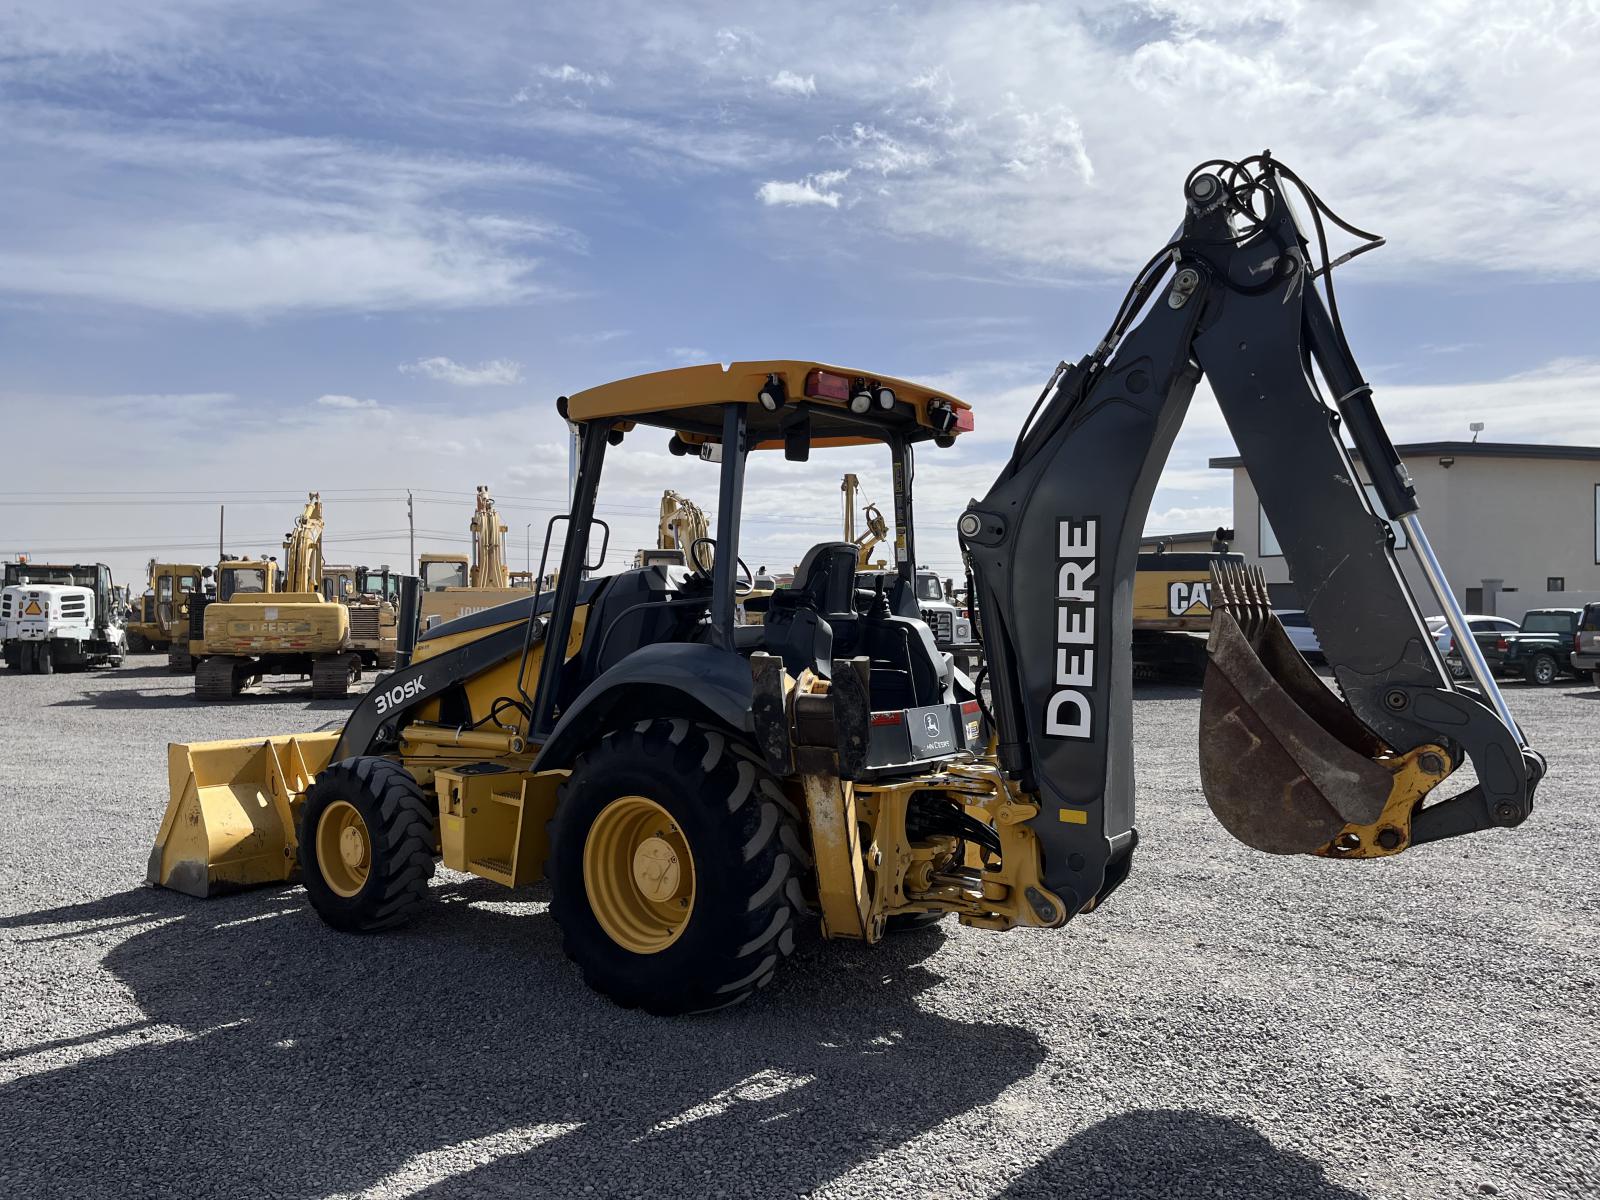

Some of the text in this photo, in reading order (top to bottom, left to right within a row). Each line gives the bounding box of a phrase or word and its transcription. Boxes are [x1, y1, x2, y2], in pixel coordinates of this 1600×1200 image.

[1170, 582, 1212, 615] CA
[1046, 520, 1096, 738] DEERE
[375, 674, 426, 715] 310SK
